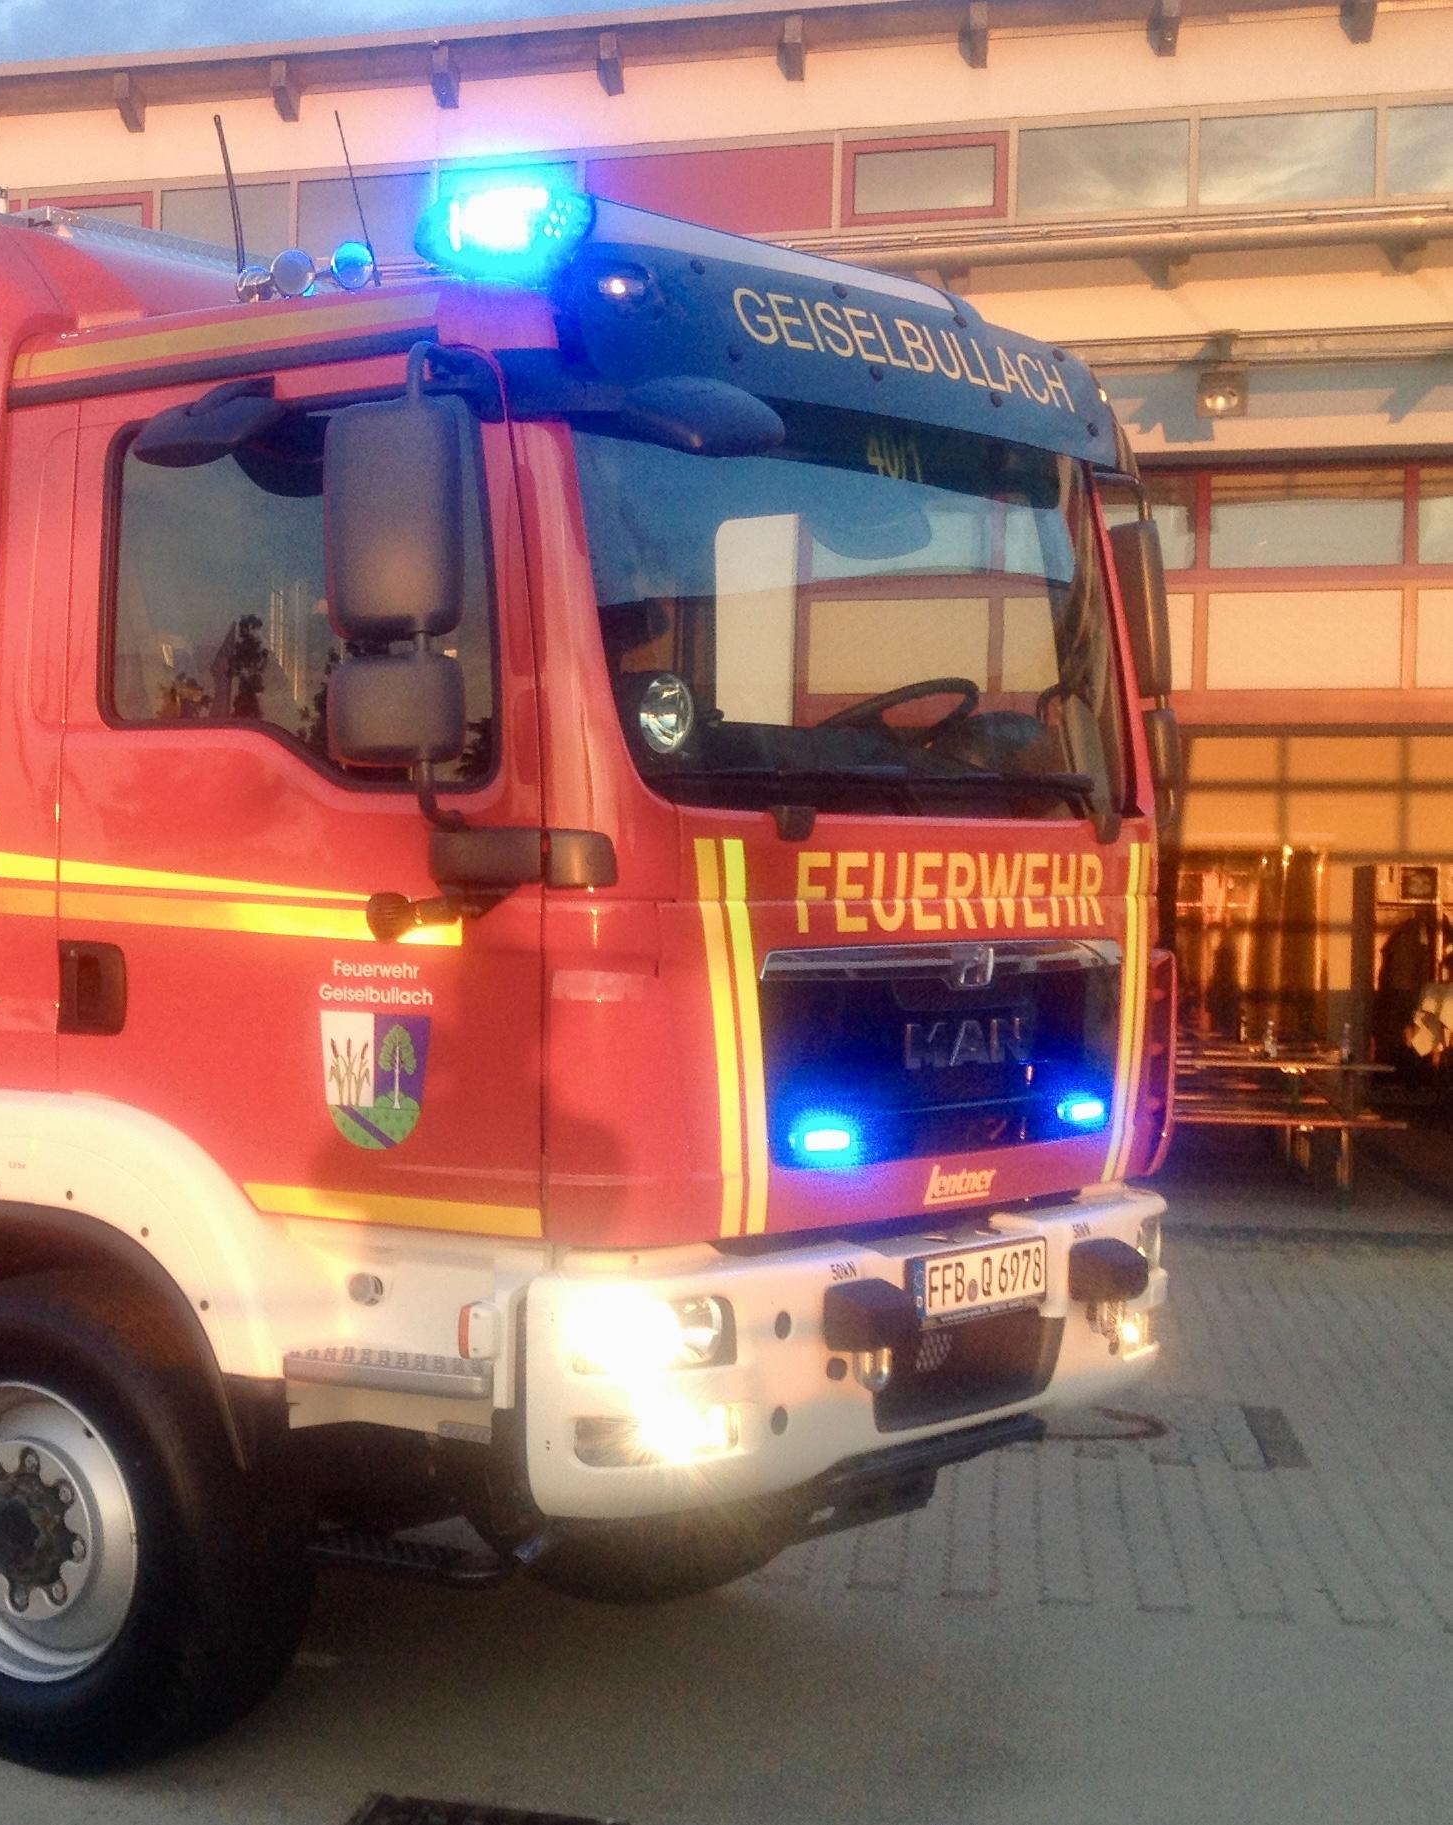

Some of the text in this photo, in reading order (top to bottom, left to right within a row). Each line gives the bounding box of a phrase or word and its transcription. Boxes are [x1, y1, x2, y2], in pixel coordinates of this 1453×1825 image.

[733, 287, 1075, 413] GEISELBULLACH
[796, 852, 1104, 933] FEUERWEHR
[319, 983, 433, 1005] Geiselbullach
[332, 959, 419, 979] Feuerwehr
[904, 1016, 1031, 1070] MAN
[928, 1261, 965, 1308] FFB
[981, 1257, 992, 1297] Q
[998, 1246, 1042, 1294] 6978
